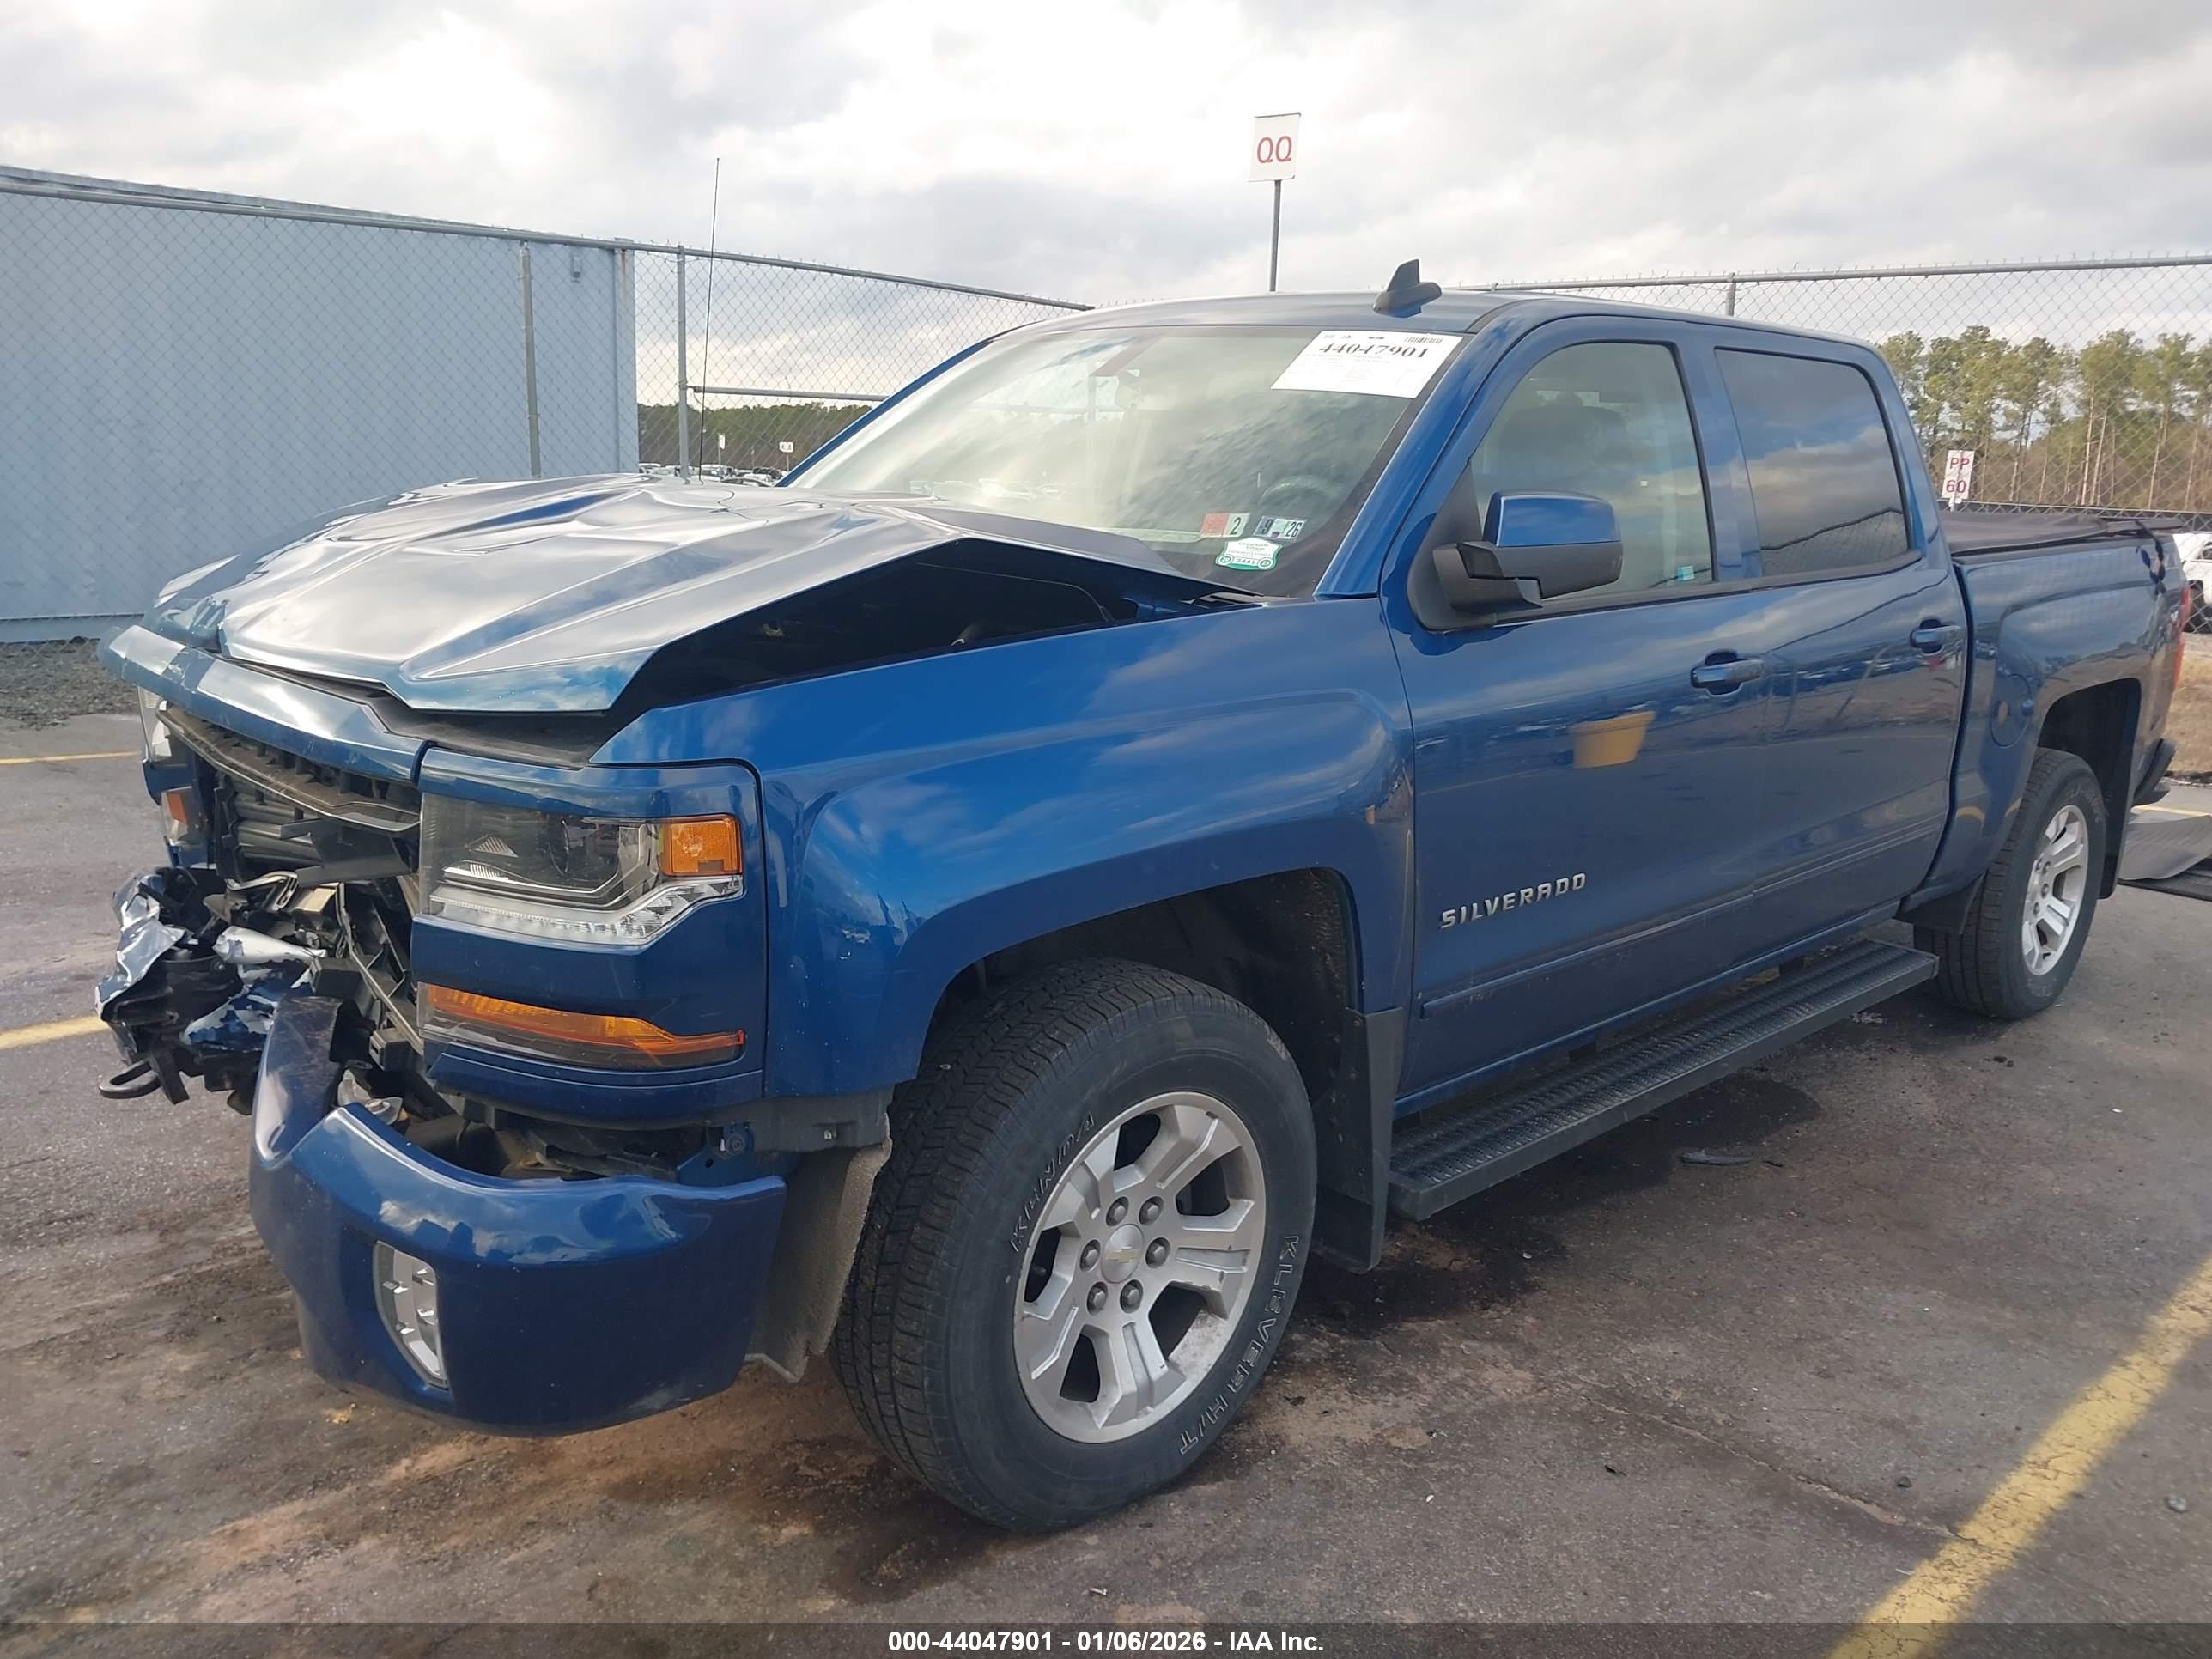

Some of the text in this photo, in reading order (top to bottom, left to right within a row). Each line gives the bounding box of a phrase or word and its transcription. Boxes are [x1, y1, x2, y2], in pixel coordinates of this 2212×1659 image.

[1256, 135, 1292, 164] QQ
[1319, 343, 1429, 358] 44047901
[1950, 457, 1971, 470] PP
[1946, 479, 1966, 494] 60
[1230, 517, 1242, 536] 2
[1285, 521, 1303, 538] 26
[1440, 872, 1587, 929] SILVERADO
[1226, 1236, 1300, 1393] KLEVER
